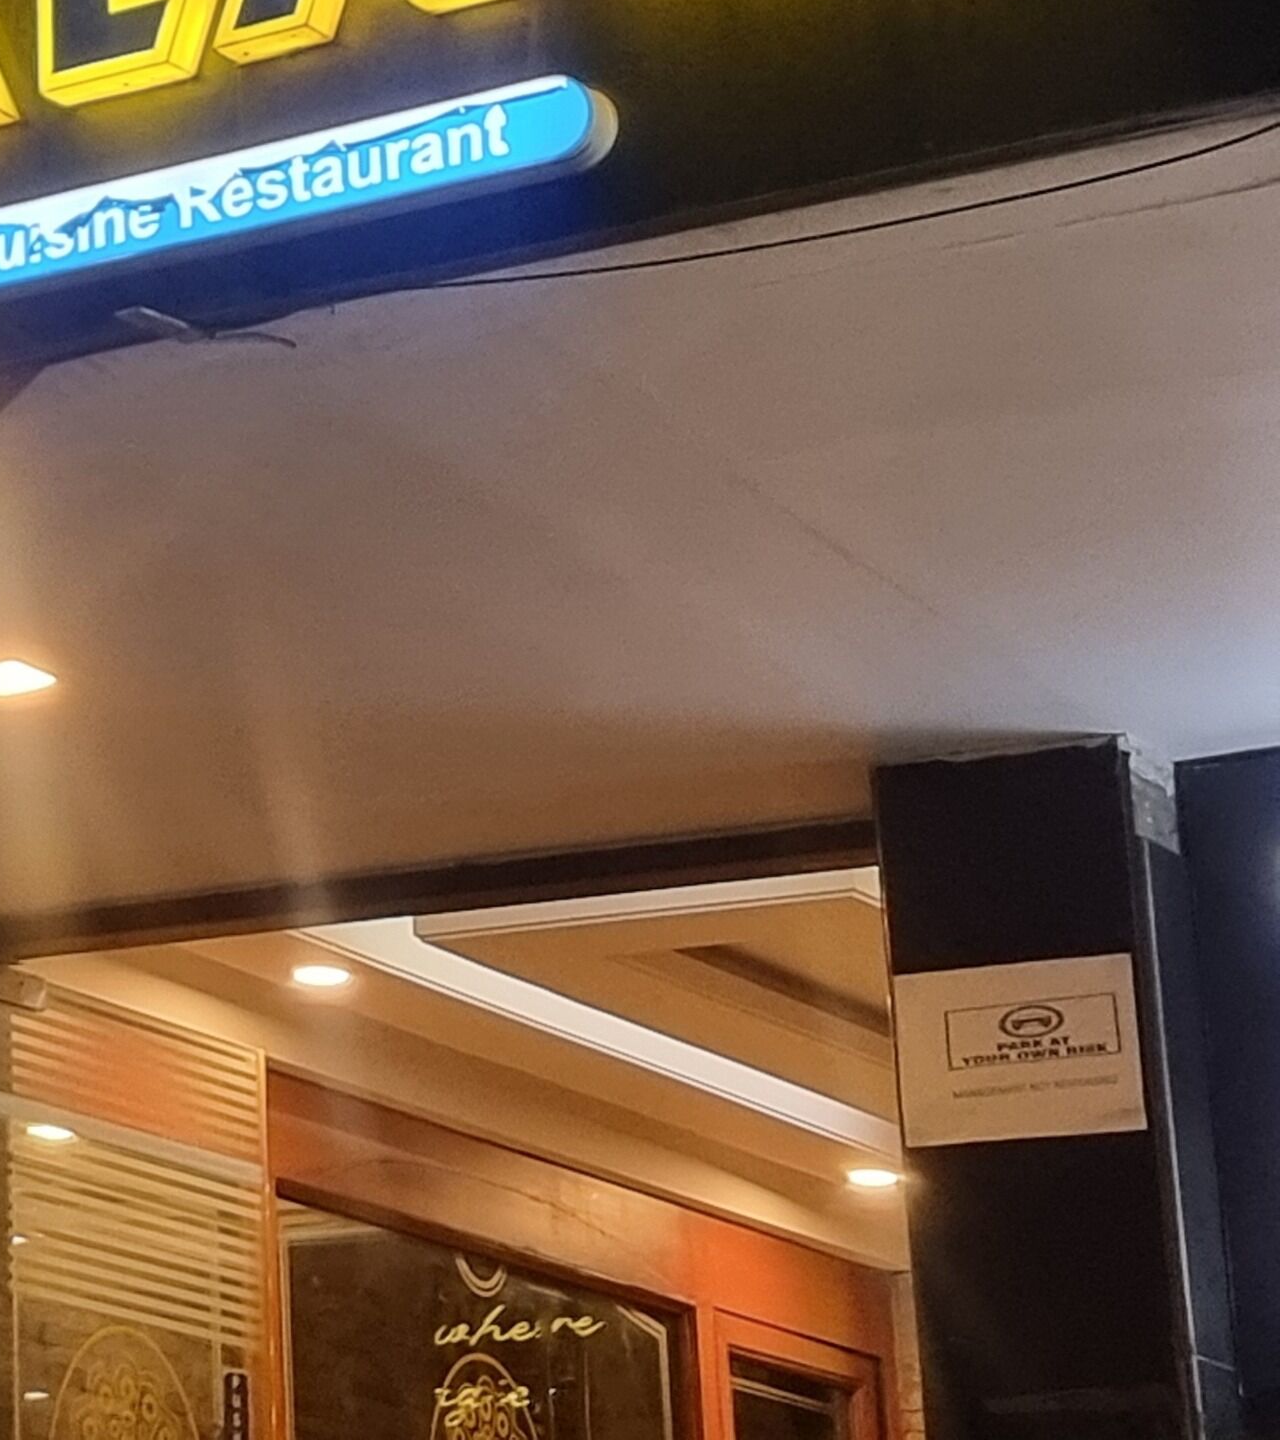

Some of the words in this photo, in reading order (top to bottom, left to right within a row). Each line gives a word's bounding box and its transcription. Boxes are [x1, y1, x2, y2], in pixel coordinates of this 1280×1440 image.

[178, 102, 511, 229] Restaurant
[962, 1054, 1010, 1067] YOUR
[1017, 1048, 1060, 1061] OWN
[1067, 1043, 1108, 1056] RISK
[996, 1039, 1043, 1052] PARK
[1049, 1036, 1071, 1047] AT
